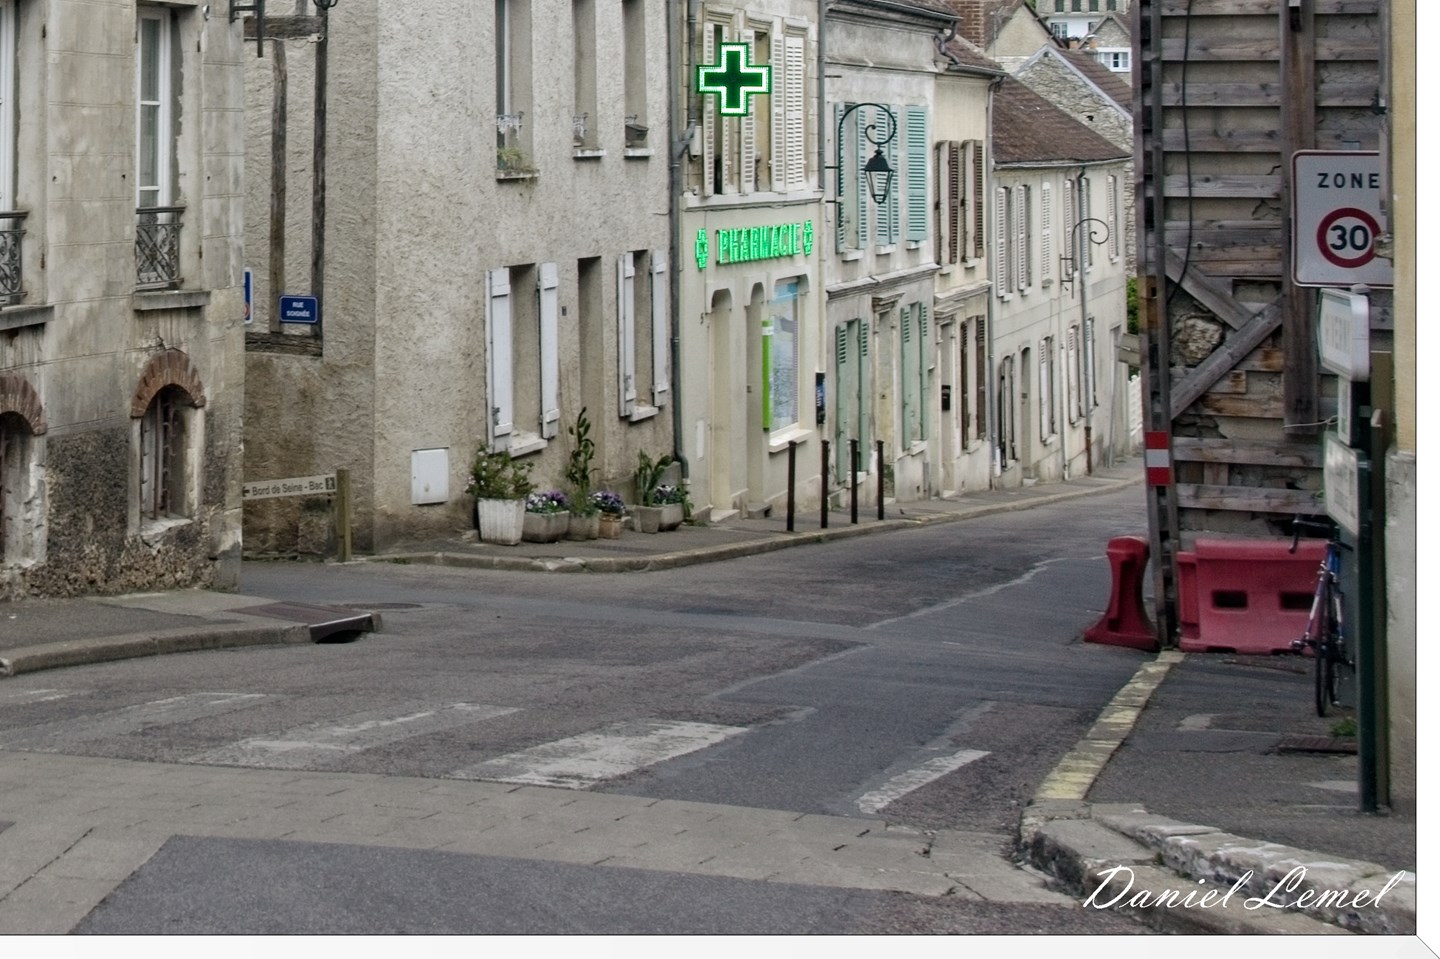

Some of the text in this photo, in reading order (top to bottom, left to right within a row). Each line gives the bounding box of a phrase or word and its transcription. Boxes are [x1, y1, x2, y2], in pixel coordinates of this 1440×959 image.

[1317, 172, 1380, 189] ZONE
[718, 223, 801, 265] PHARMACIE
[1329, 224, 1370, 251] 30
[252, 486, 270, 496] Bord
[271, 485, 281, 494] de
[282, 483, 303, 493] Seine
[309, 480, 324, 491] Bac
